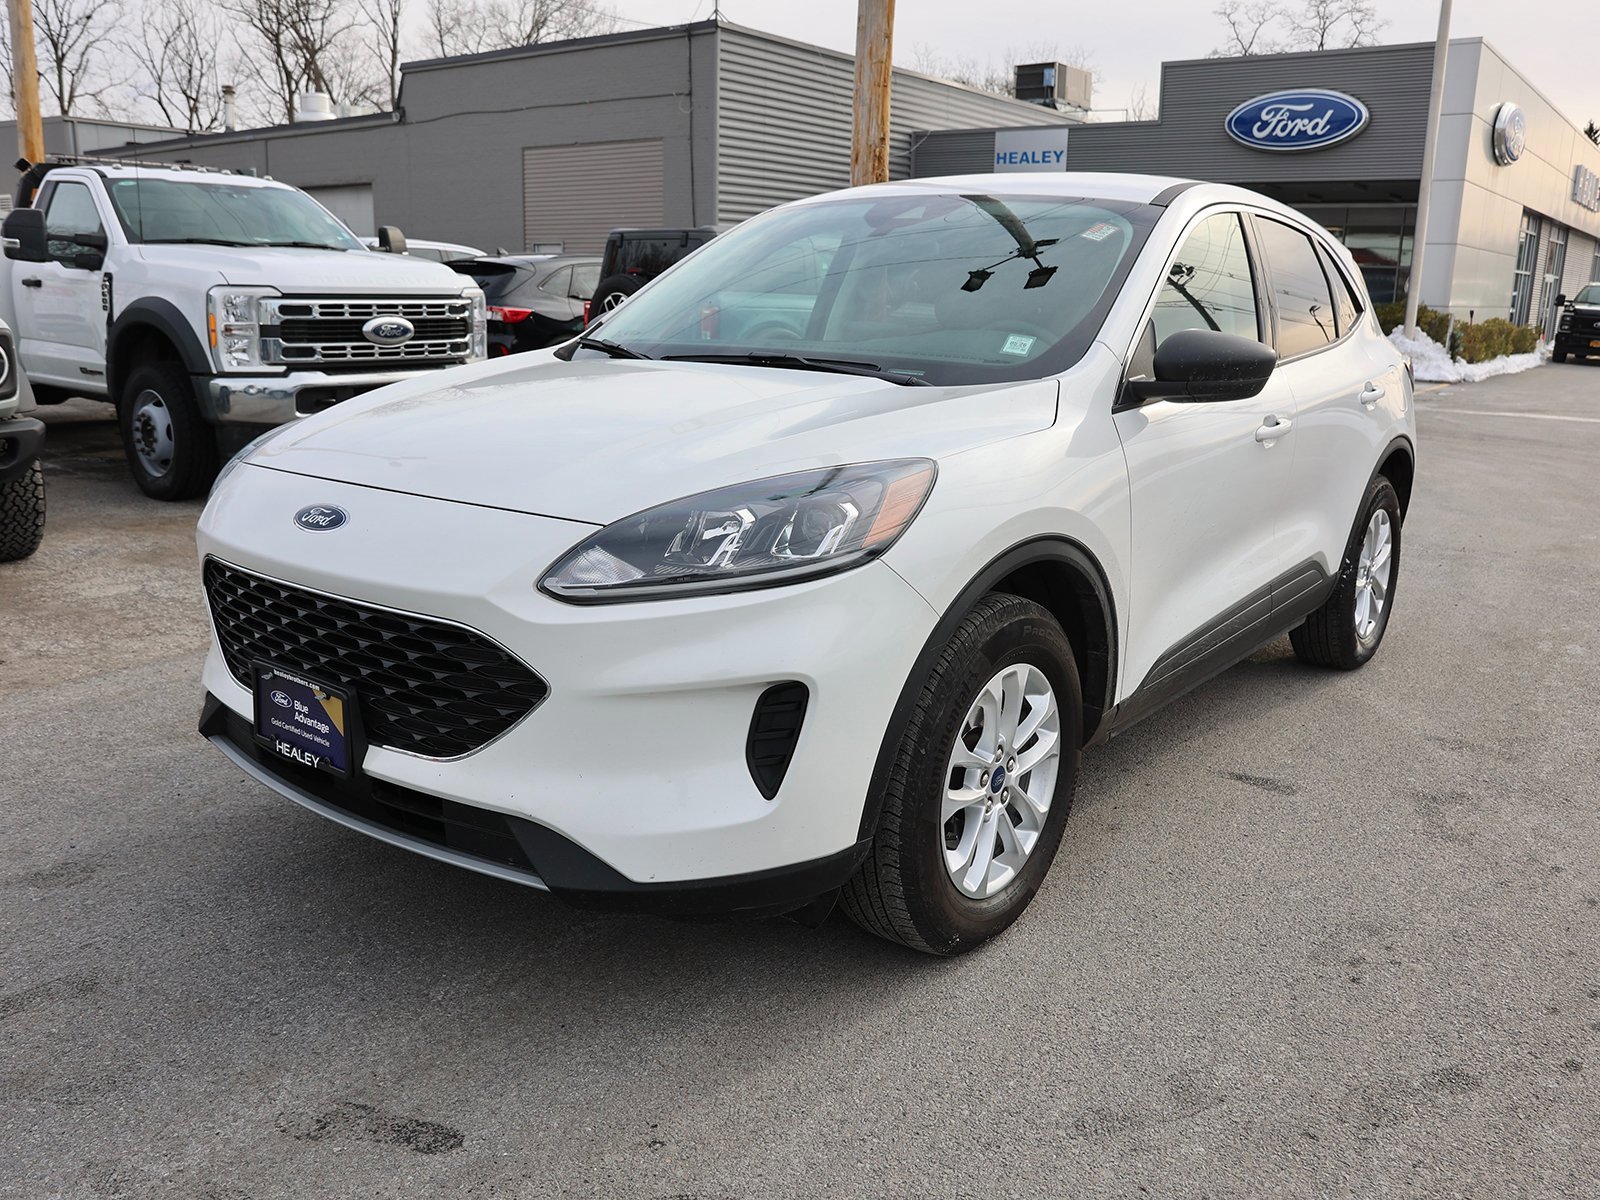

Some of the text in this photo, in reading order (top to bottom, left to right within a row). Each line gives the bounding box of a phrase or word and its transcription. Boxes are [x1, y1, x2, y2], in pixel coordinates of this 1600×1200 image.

[1252, 103, 1334, 138] Ford
[996, 150, 1064, 165] HEALEY
[379, 324, 404, 337] Ford
[302, 507, 336, 526] Ford
[273, 669, 320, 691] healeybrothers.com
[294, 700, 309, 714] Blue
[271, 717, 330, 748] Gold Certified Used Vehicle
[294, 711, 330, 734] Advantage
[276, 740, 320, 769] HEALEY
